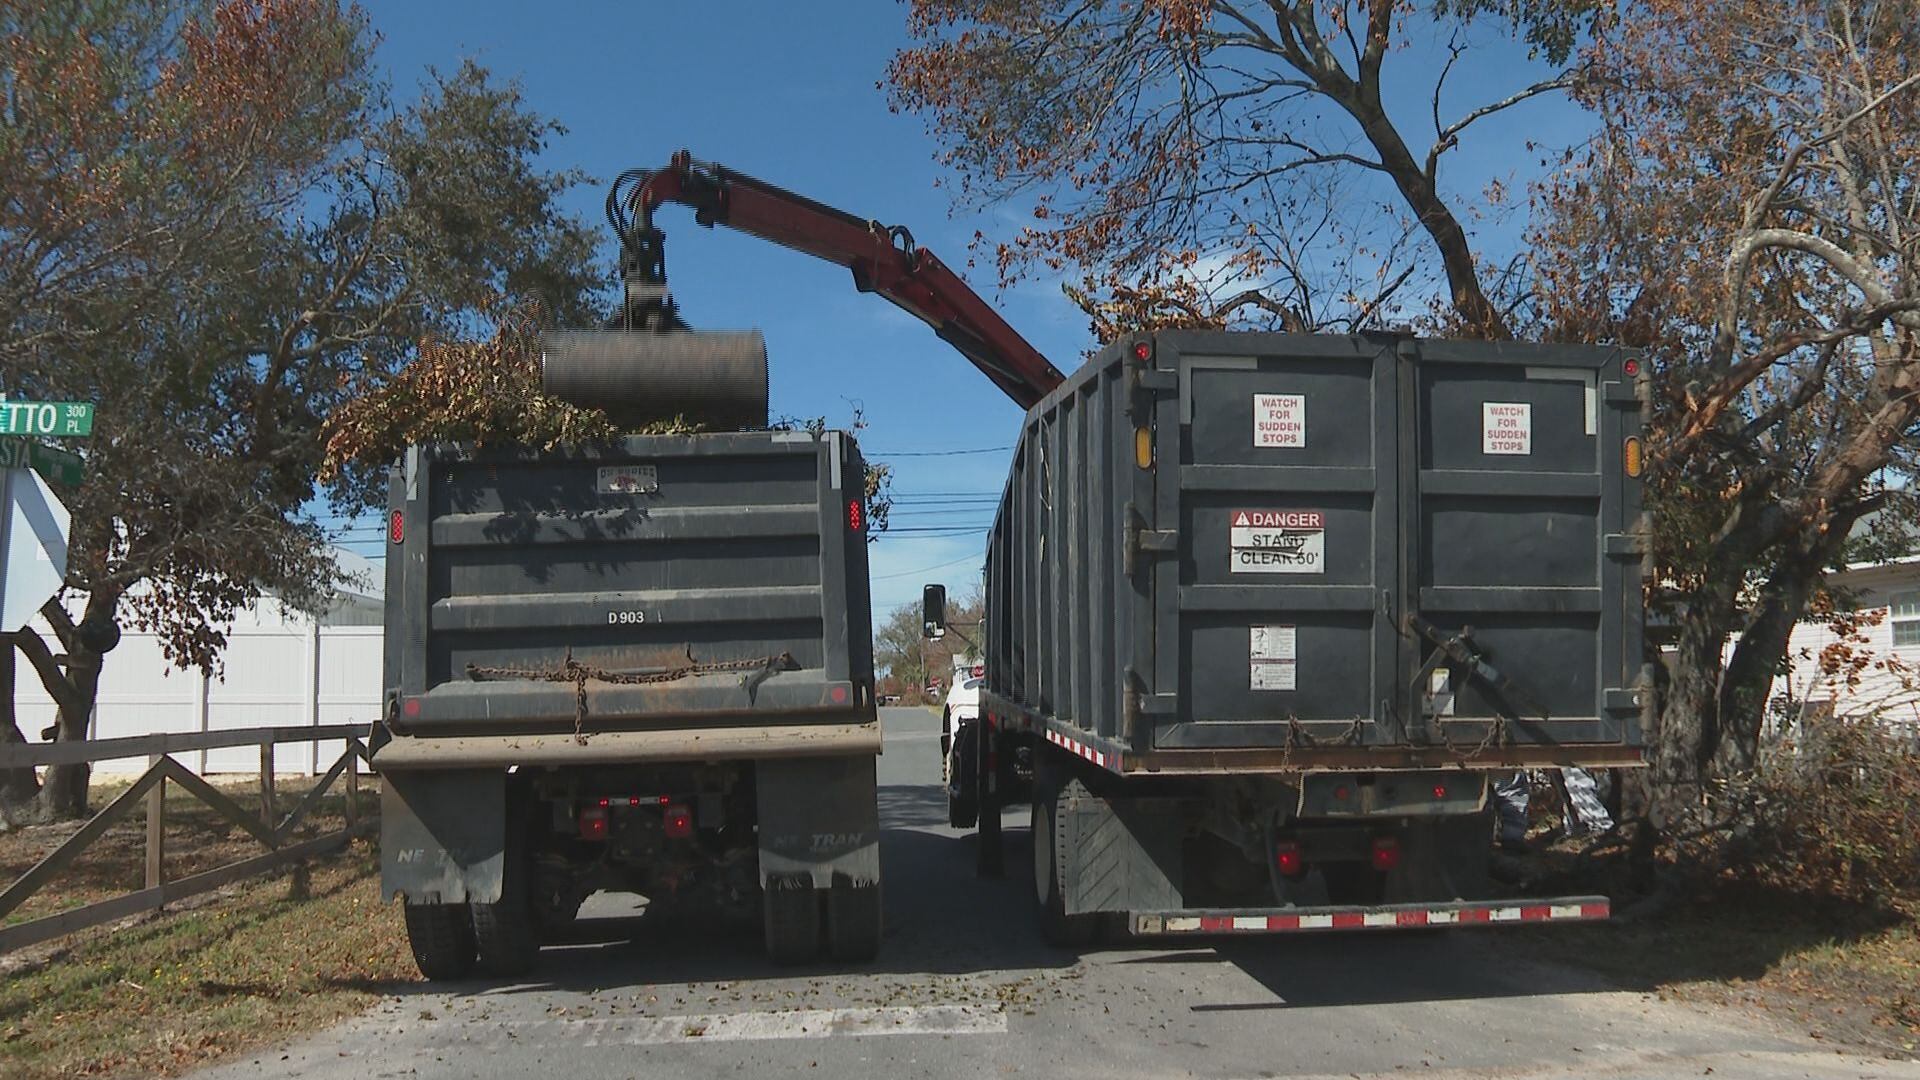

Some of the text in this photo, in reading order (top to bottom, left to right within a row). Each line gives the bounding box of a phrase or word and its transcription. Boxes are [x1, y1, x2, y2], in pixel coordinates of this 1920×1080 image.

[1261, 398, 1298, 408] WATCH
[65, 405, 86, 418] 300
[1269, 410, 1290, 420] FOR
[1490, 407, 1524, 416] WATCH
[66, 420, 80, 433] PL
[1258, 422, 1301, 431] SUDDEN
[1497, 418, 1517, 428] FOR
[1263, 434, 1297, 443] STOPS
[1487, 430, 1527, 439] SUDDEN
[1491, 442, 1523, 451] STOPS
[1252, 513, 1320, 527] DANGER
[1252, 534, 1305, 547] STAND
[619, 611, 645, 624] 903
